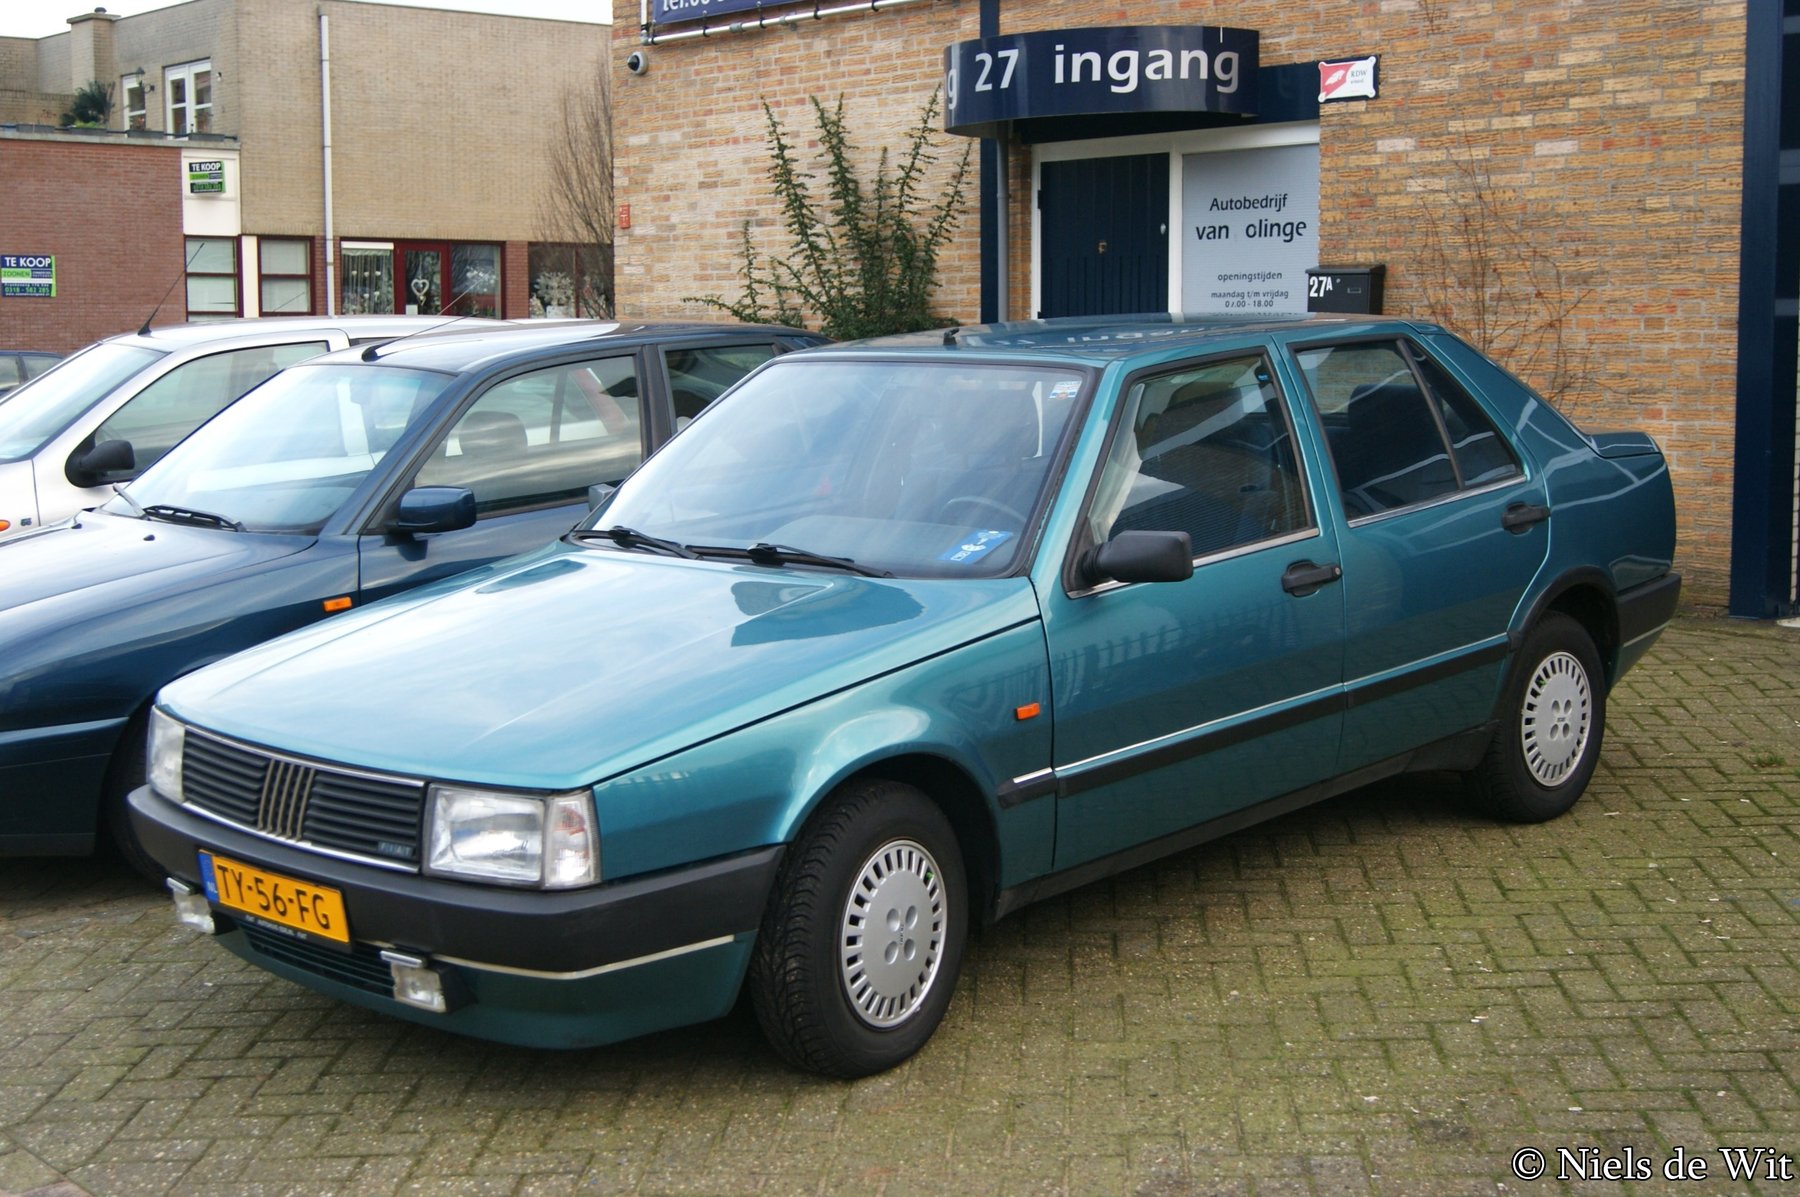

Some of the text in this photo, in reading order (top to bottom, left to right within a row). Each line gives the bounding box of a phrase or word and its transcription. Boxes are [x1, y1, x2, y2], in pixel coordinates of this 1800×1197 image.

[975, 44, 1240, 93] 27 ingang
[201, 162, 221, 170] KOOP
[1209, 193, 1288, 212] Autobedrijf
[1196, 219, 1307, 243] van olinge
[4, 257, 51, 267] TE KOOP
[1217, 272, 1283, 283] openingstijden
[1211, 290, 1289, 300] maandag t/m vrijdag
[207, 880, 218, 893] NL
[217, 864, 331, 930] TY-56-FG
